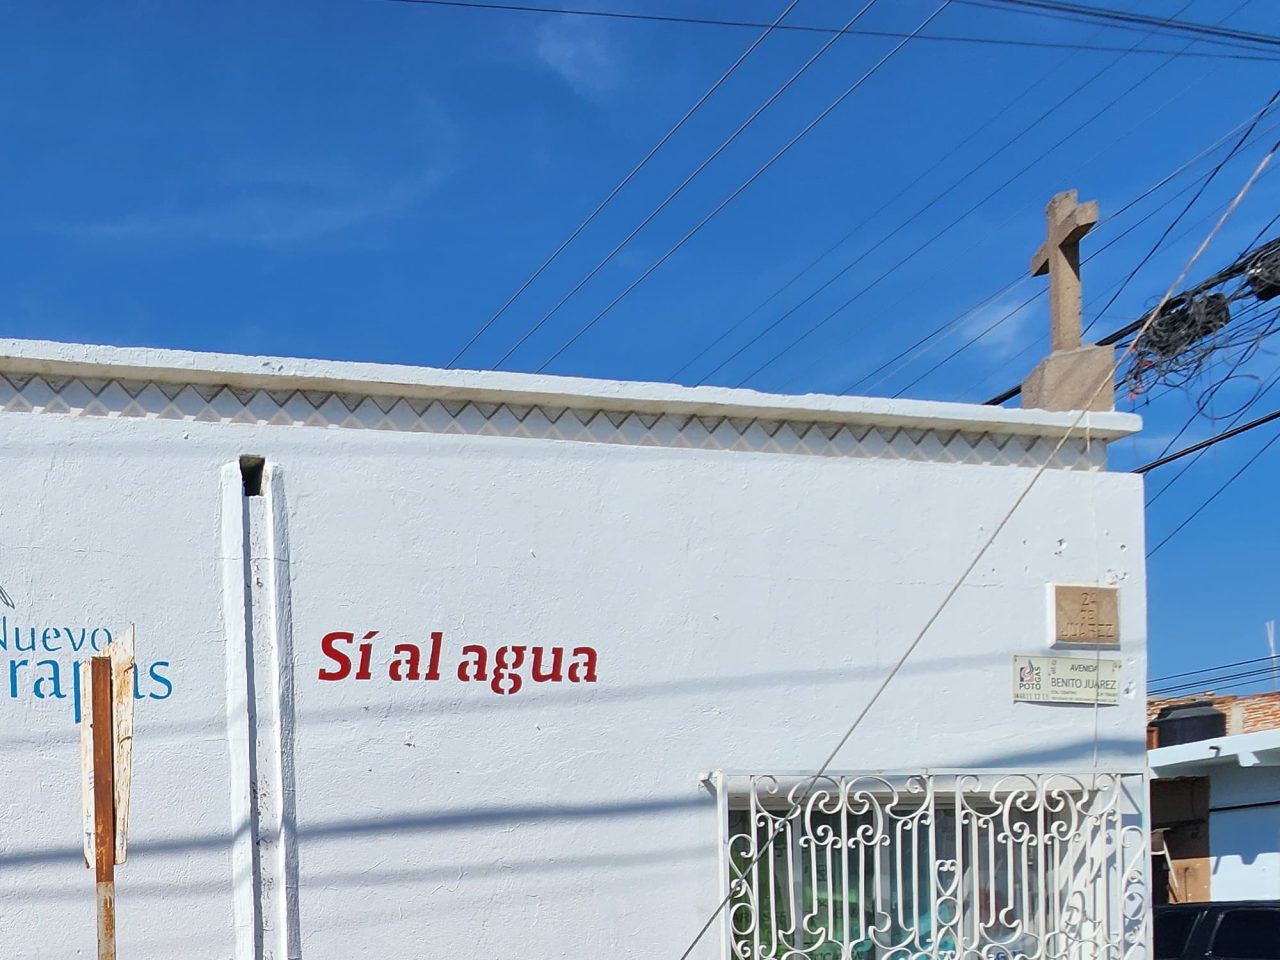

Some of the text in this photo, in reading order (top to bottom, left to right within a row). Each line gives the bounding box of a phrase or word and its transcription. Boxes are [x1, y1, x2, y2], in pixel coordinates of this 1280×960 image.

[318, 631, 598, 695] Sí al agua
[1070, 664, 1098, 672] AVENIDA
[1019, 682, 1041, 690] POTO
[1051, 677, 1116, 690] BENITO JUAREZ
